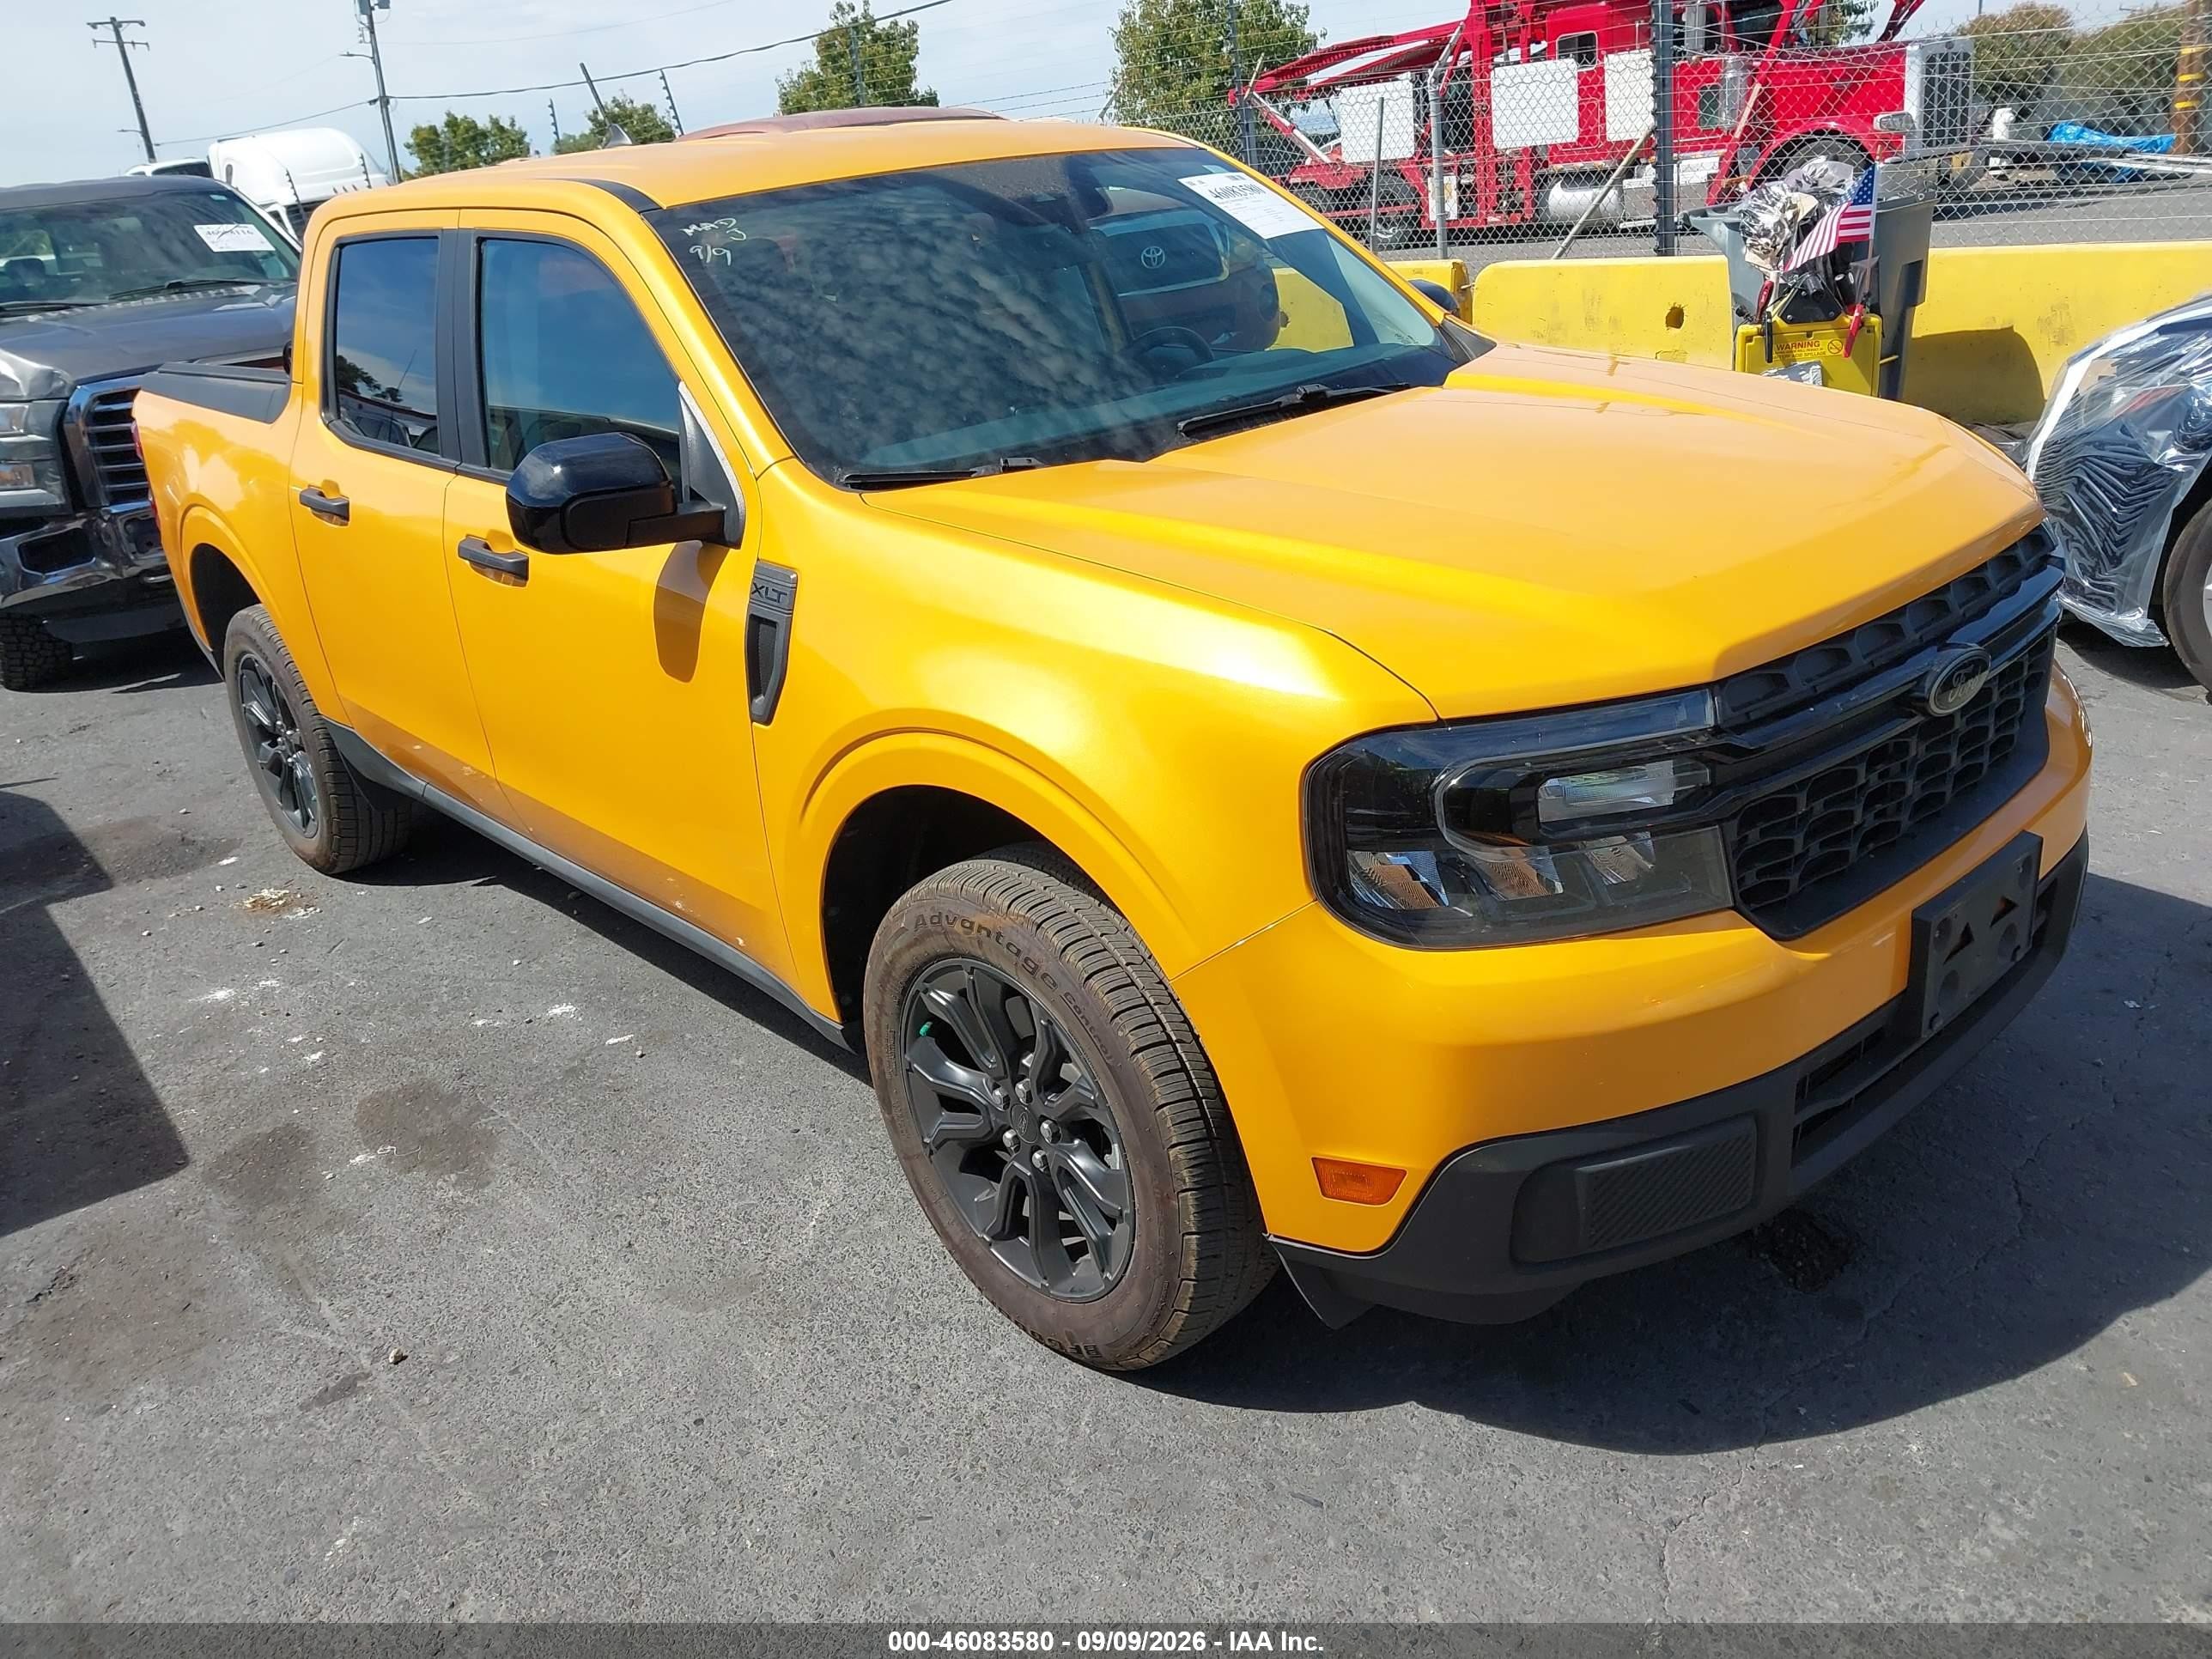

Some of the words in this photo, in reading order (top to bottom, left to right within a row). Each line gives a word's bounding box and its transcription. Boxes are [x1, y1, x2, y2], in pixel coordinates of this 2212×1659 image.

[689, 244, 732, 266] 9/9
[1776, 340, 1820, 350] WARNING
[751, 582, 787, 604] XLT
[1948, 664, 1983, 703] Ford
[914, 911, 1058, 990] Advantage
